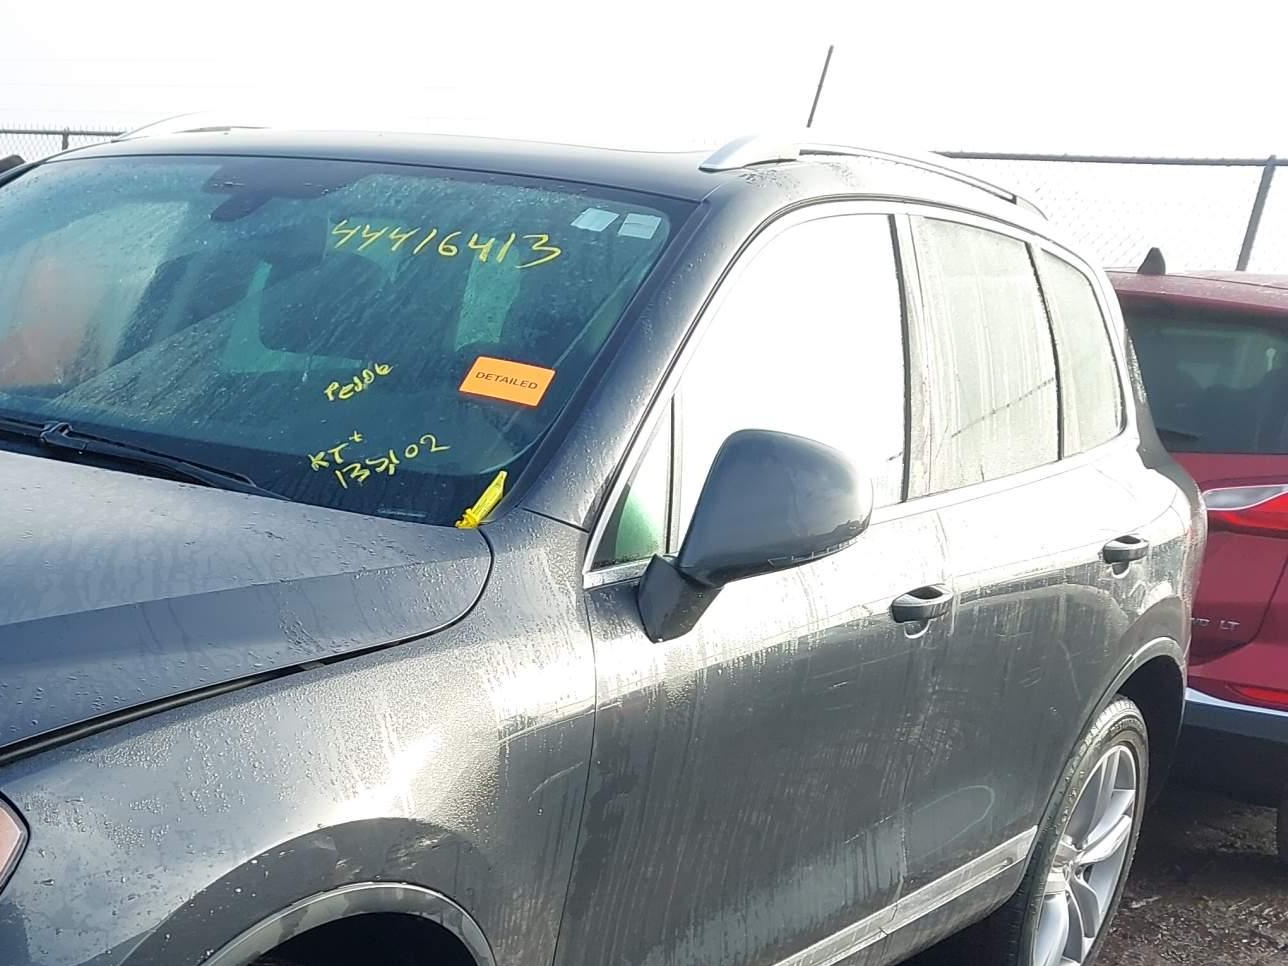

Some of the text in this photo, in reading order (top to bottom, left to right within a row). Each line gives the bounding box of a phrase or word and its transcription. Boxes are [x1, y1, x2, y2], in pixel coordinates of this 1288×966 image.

[330, 218, 563, 270] 44416413
[474, 371, 539, 391] DETAILED
[1219, 619, 1241, 631] LT
